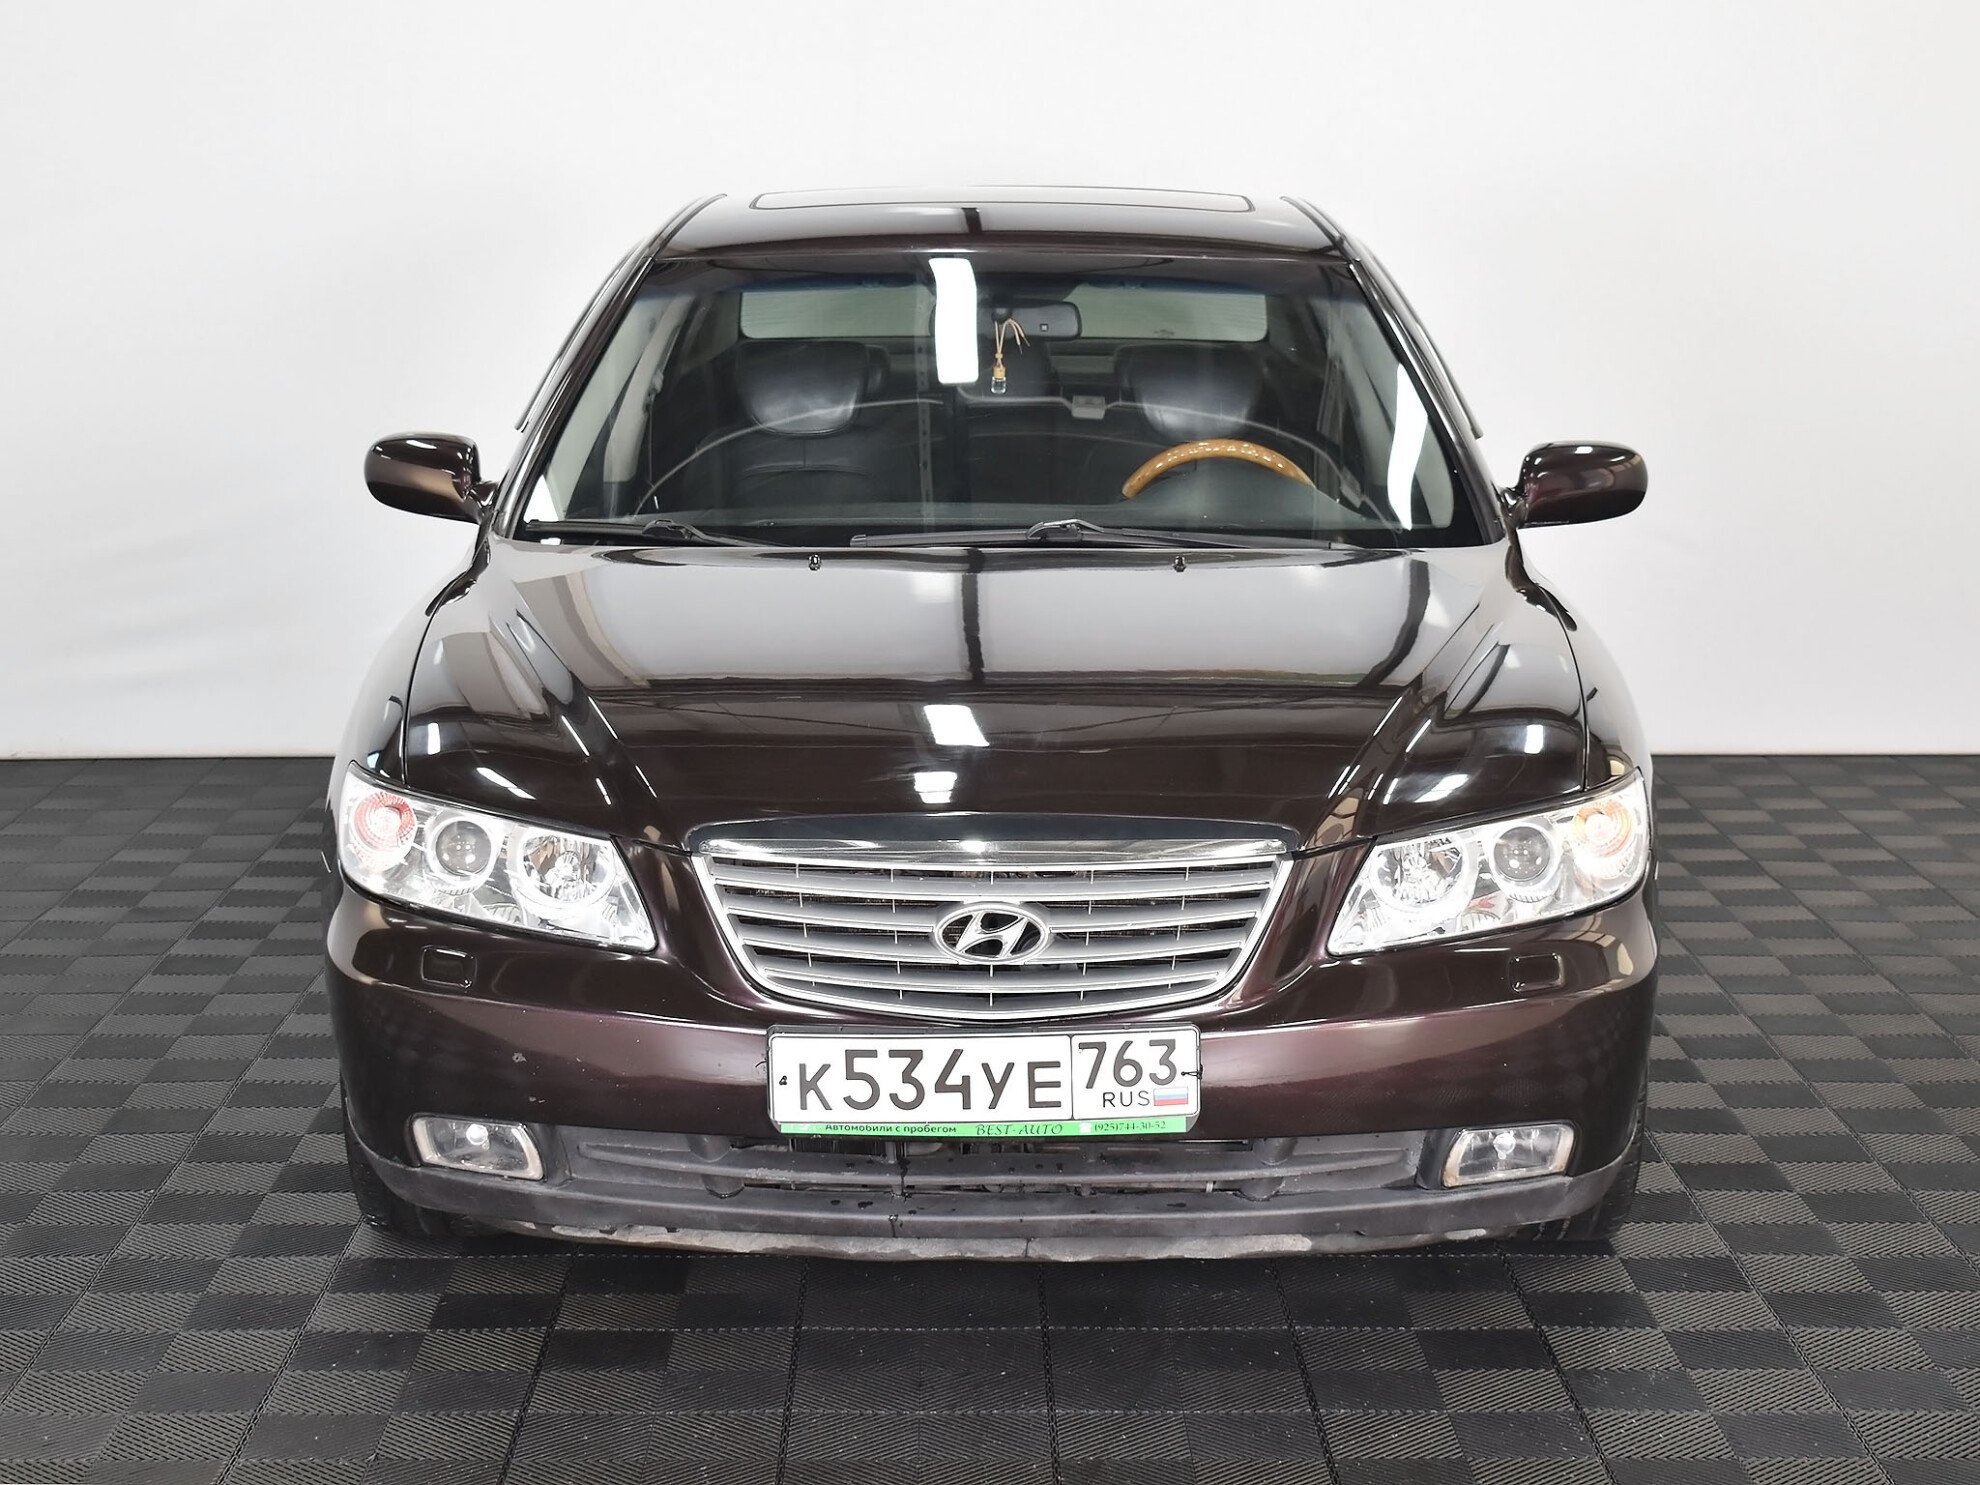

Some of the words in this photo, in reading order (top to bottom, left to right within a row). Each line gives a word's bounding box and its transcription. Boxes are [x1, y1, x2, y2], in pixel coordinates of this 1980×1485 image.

[1078, 1039, 1177, 1089] 763
[1102, 1090, 1151, 1108] RUS
[825, 1124, 892, 1133] Автомобили
[904, 1125, 957, 1135] пробегом
